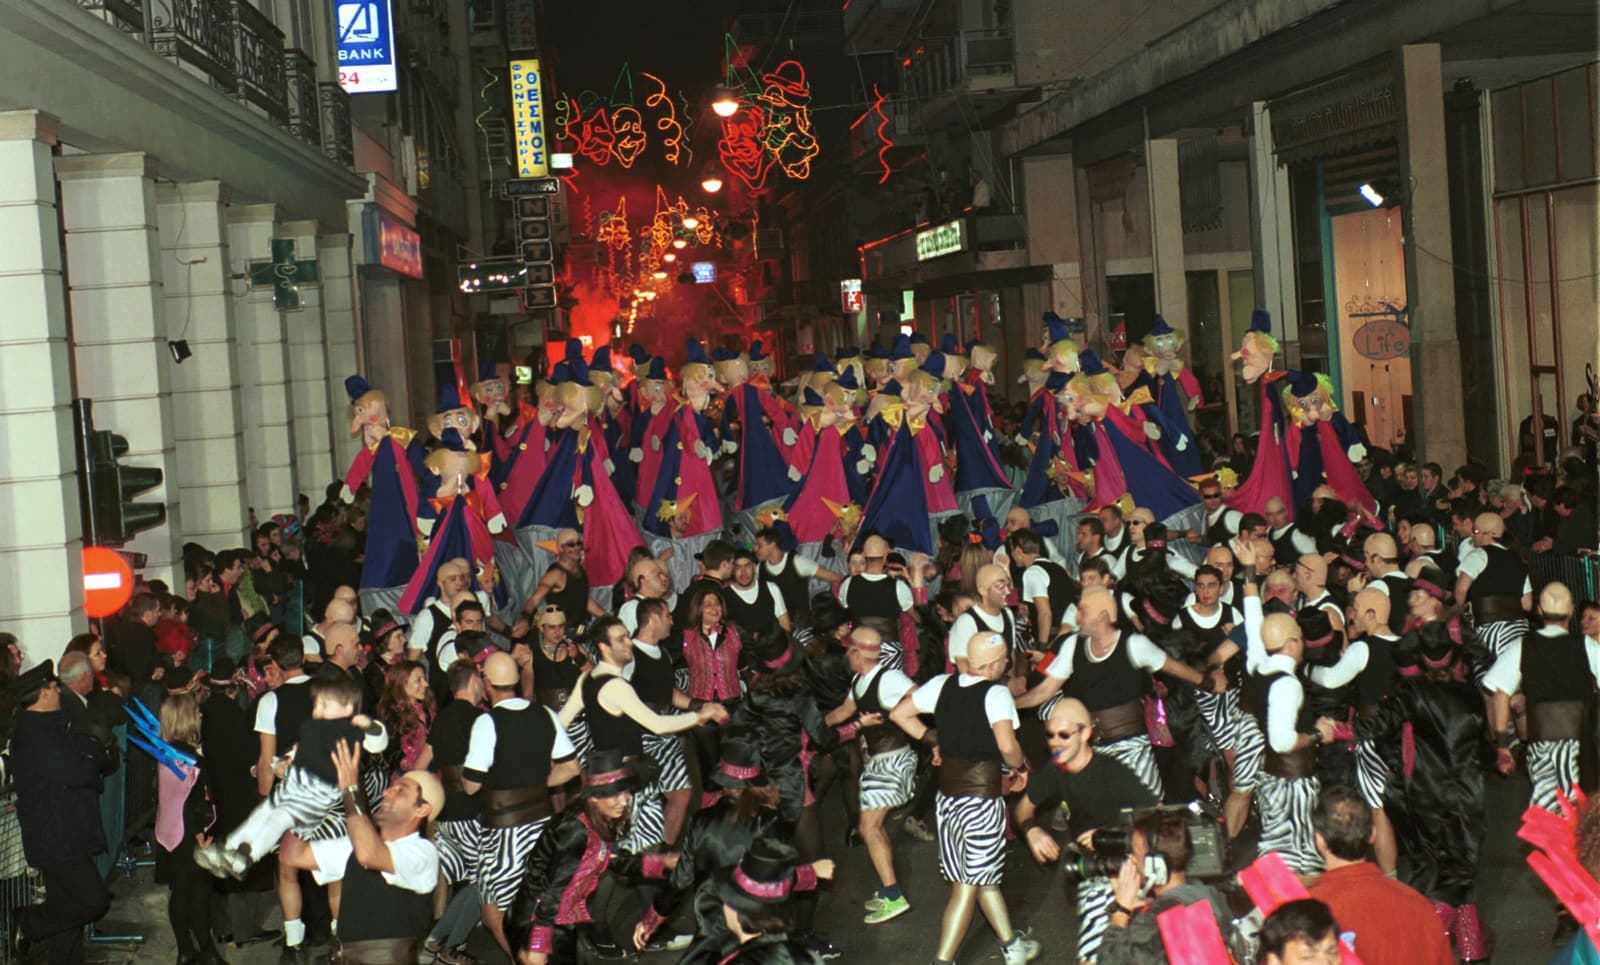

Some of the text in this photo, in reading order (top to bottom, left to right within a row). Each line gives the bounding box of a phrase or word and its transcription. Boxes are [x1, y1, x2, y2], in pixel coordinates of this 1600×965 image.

[338, 48, 385, 61] BANK
[338, 71, 361, 86] 24
[511, 64, 530, 175] ΦΡΟΝΤΙΣΤΗΡΙΑ
[525, 71, 545, 166] ΘΕΣΜΟΣ
[1365, 331, 1405, 356] Life
